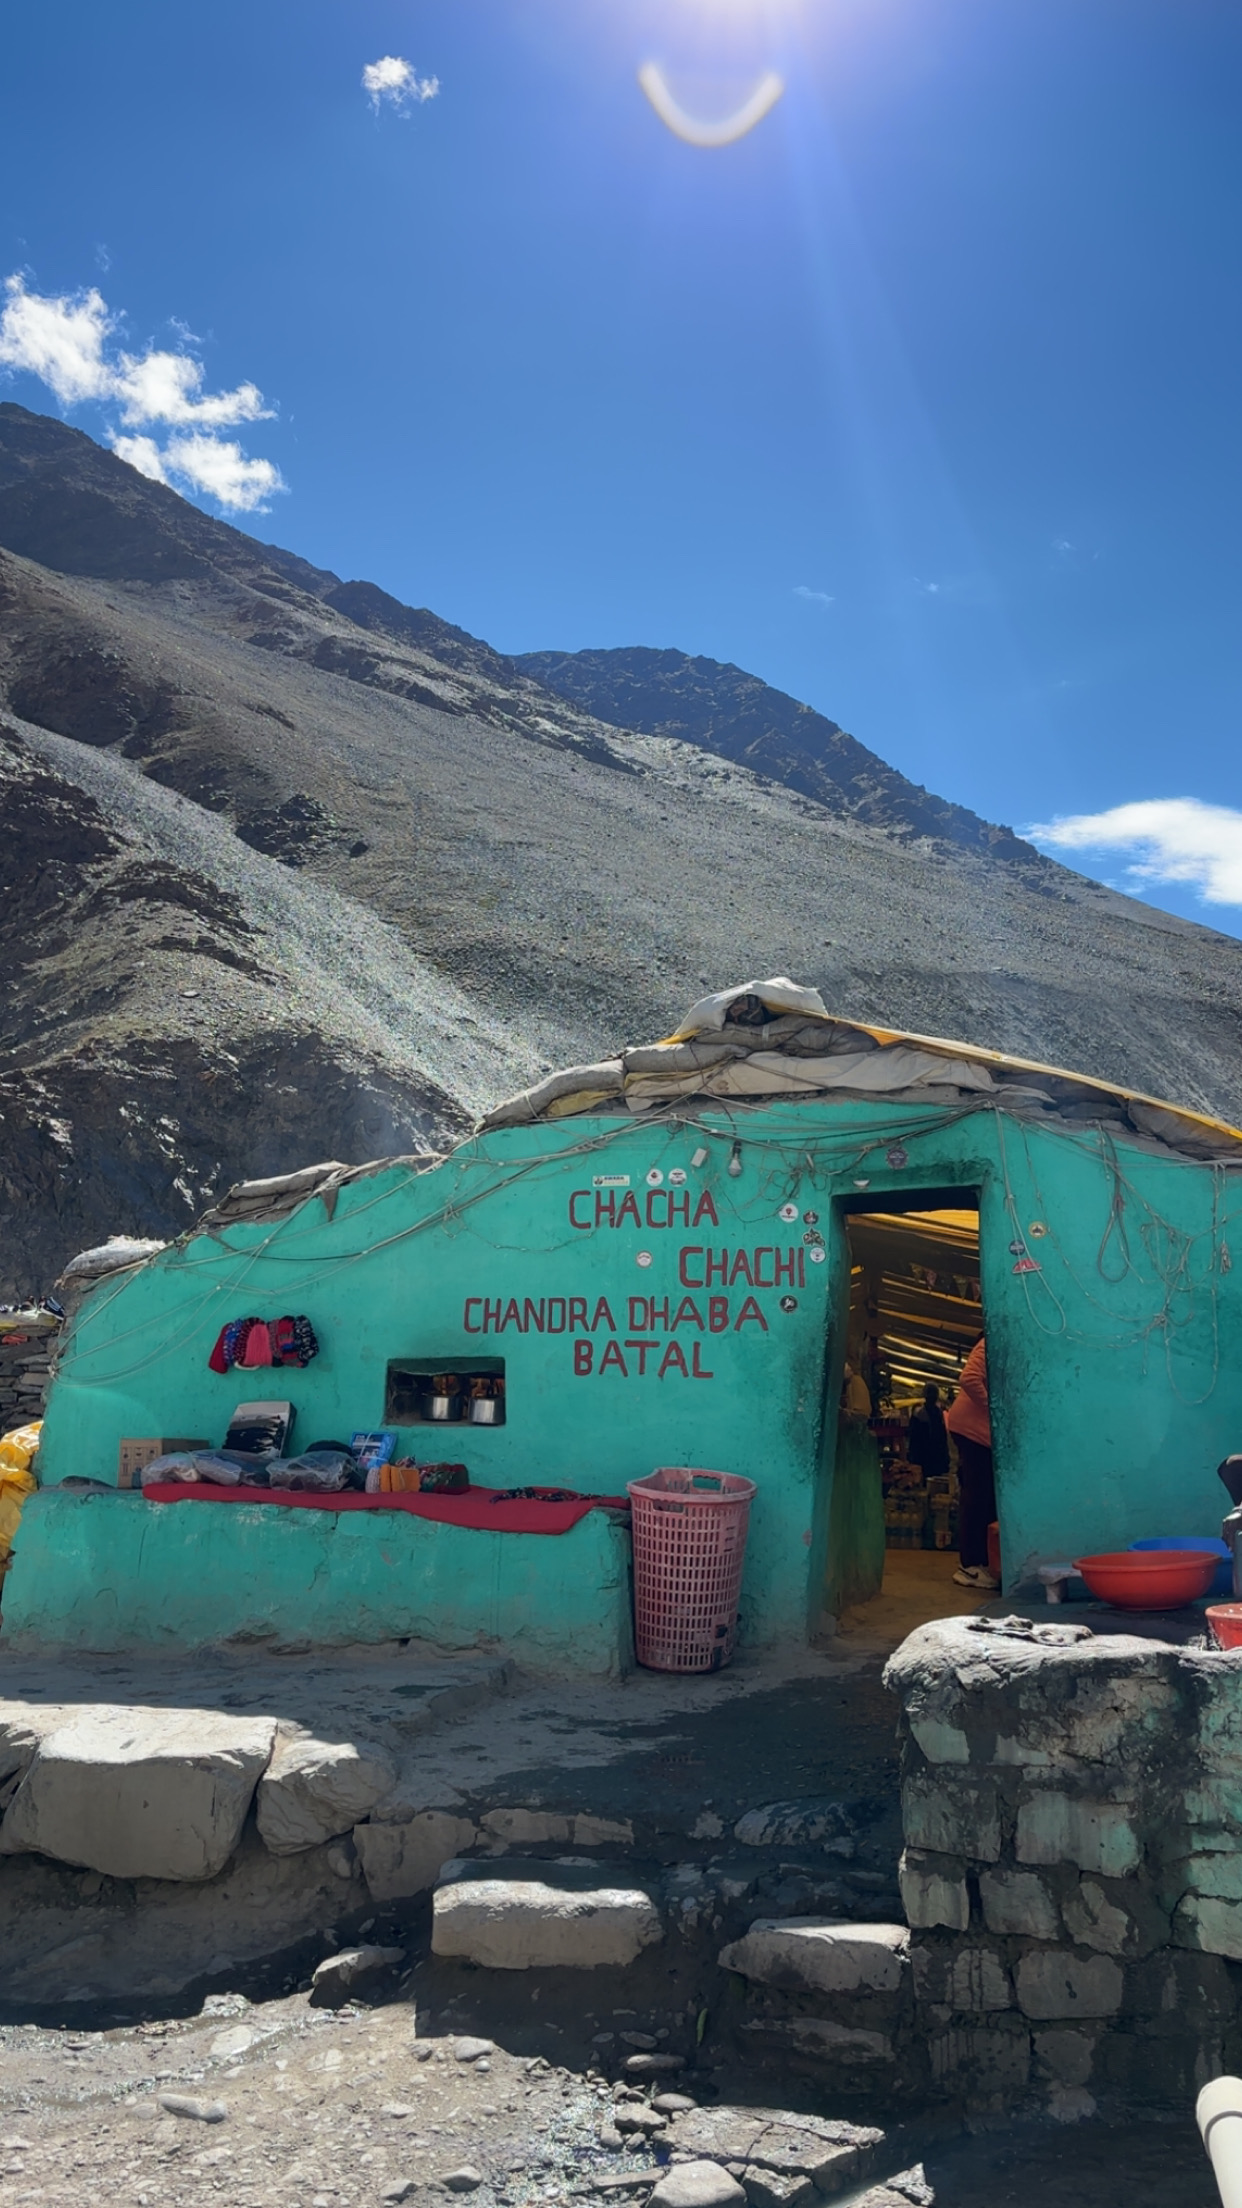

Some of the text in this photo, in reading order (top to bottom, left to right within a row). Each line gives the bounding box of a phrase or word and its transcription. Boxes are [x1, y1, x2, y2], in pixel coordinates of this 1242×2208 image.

[568, 1189, 719, 1229] CHACHA
[679, 1246, 806, 1288] CHACHI
[464, 1296, 769, 1334] CHANDRA DHABA
[574, 1339, 714, 1378] BATAL
